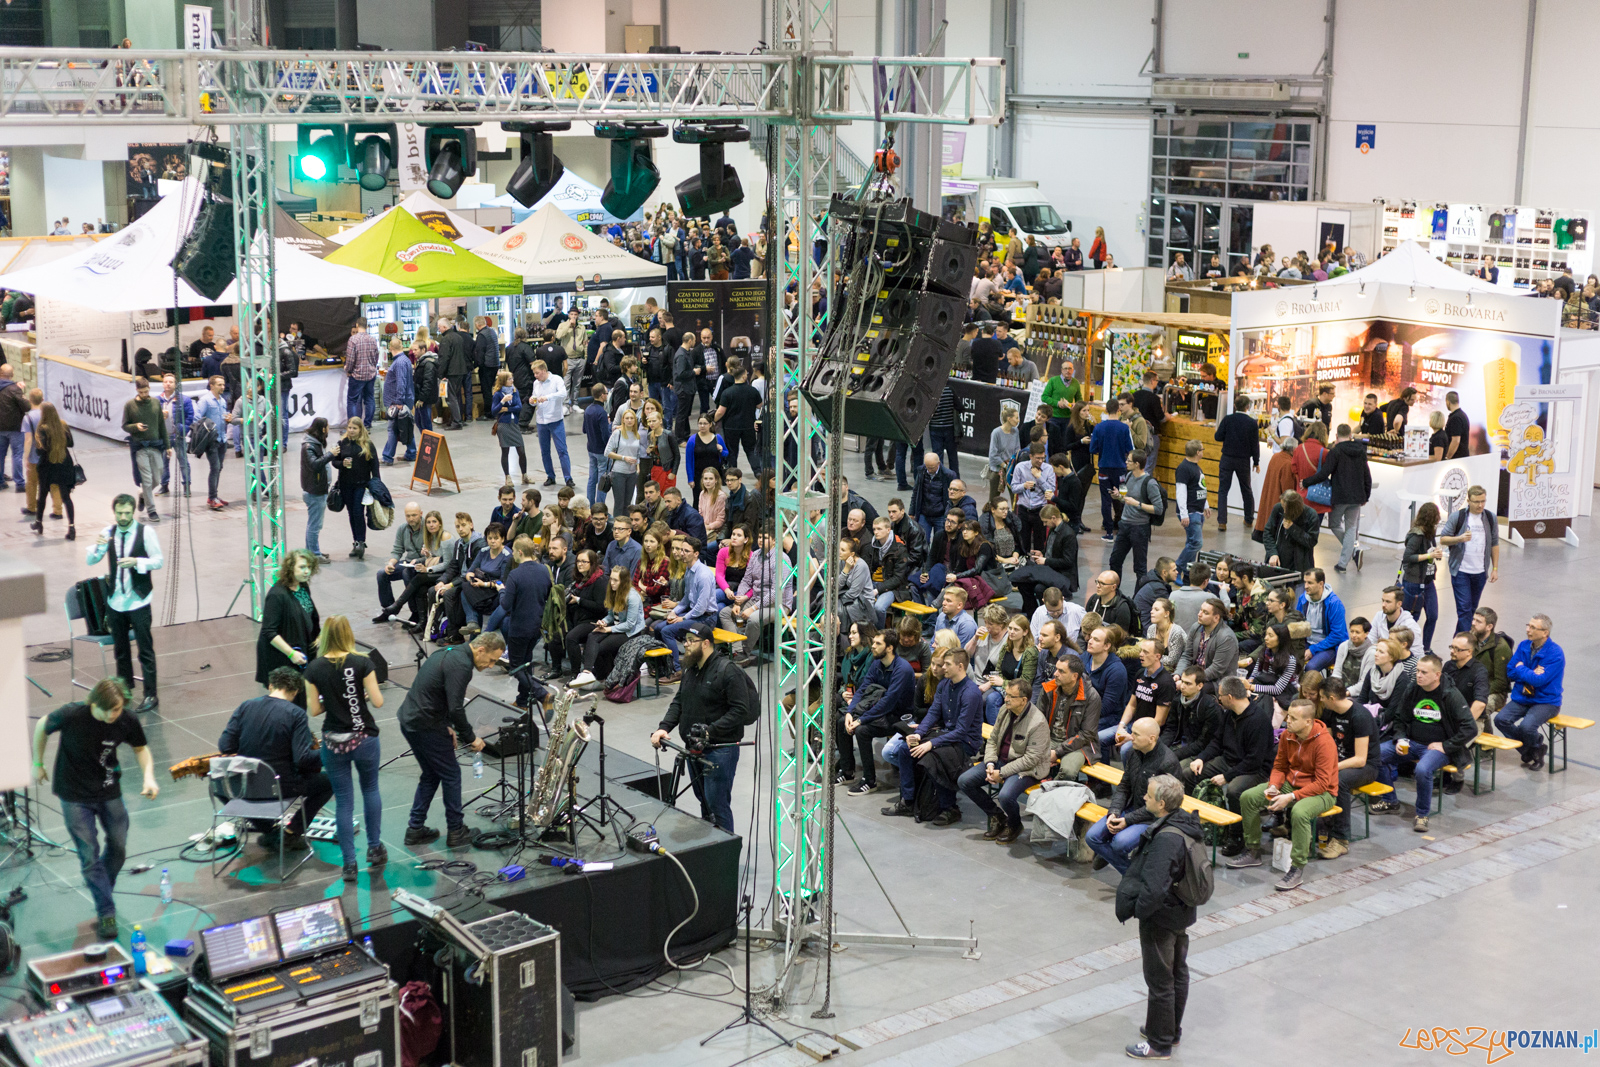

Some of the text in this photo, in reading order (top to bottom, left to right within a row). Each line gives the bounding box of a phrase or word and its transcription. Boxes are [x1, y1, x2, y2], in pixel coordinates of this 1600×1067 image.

[539, 256, 582, 265] BROWAR
[1292, 302, 1340, 314] BROVARIA
[1444, 302, 1504, 321] BROVARIA
[133, 320, 170, 332] Widawa
[1317, 355, 1360, 369] NIEWIELKI
[1422, 359, 1464, 374] WIELKIE
[1316, 368, 1351, 380] BROWAR
[1422, 371, 1452, 384] PIWO!
[60, 381, 111, 422] Widawa
[1513, 477, 1569, 501] fotka
[1526, 498, 1568, 507] wielkim
